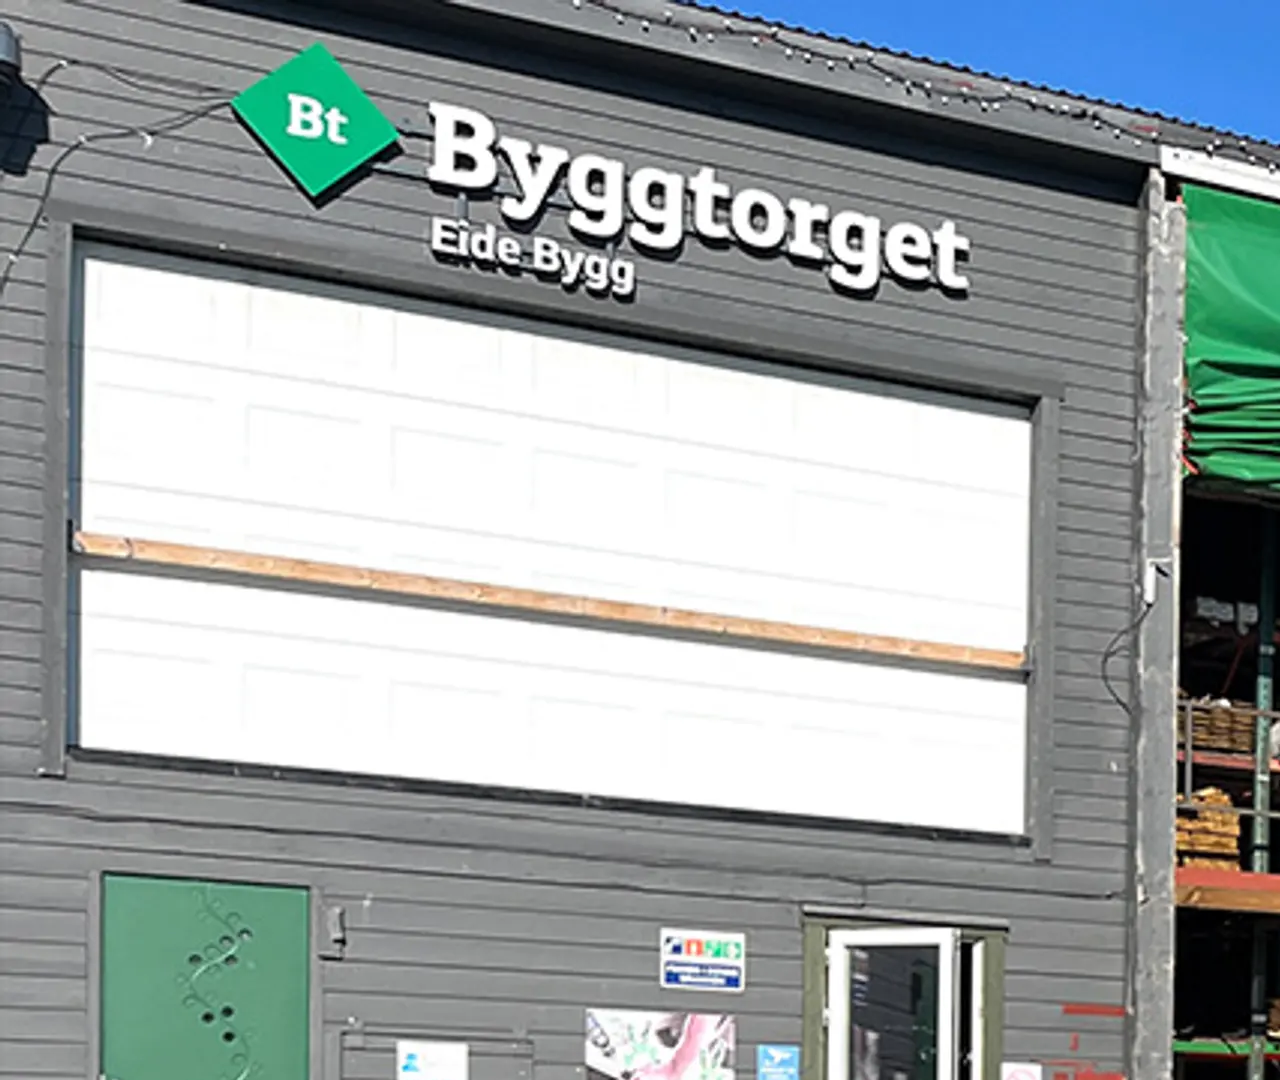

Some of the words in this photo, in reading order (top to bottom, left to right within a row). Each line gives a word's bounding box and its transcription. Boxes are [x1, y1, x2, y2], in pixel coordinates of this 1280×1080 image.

[287, 93, 347, 145] Bt
[427, 101, 971, 292] Byggtorget
[431, 216, 521, 264] Eide
[532, 236, 636, 294] Bygg
